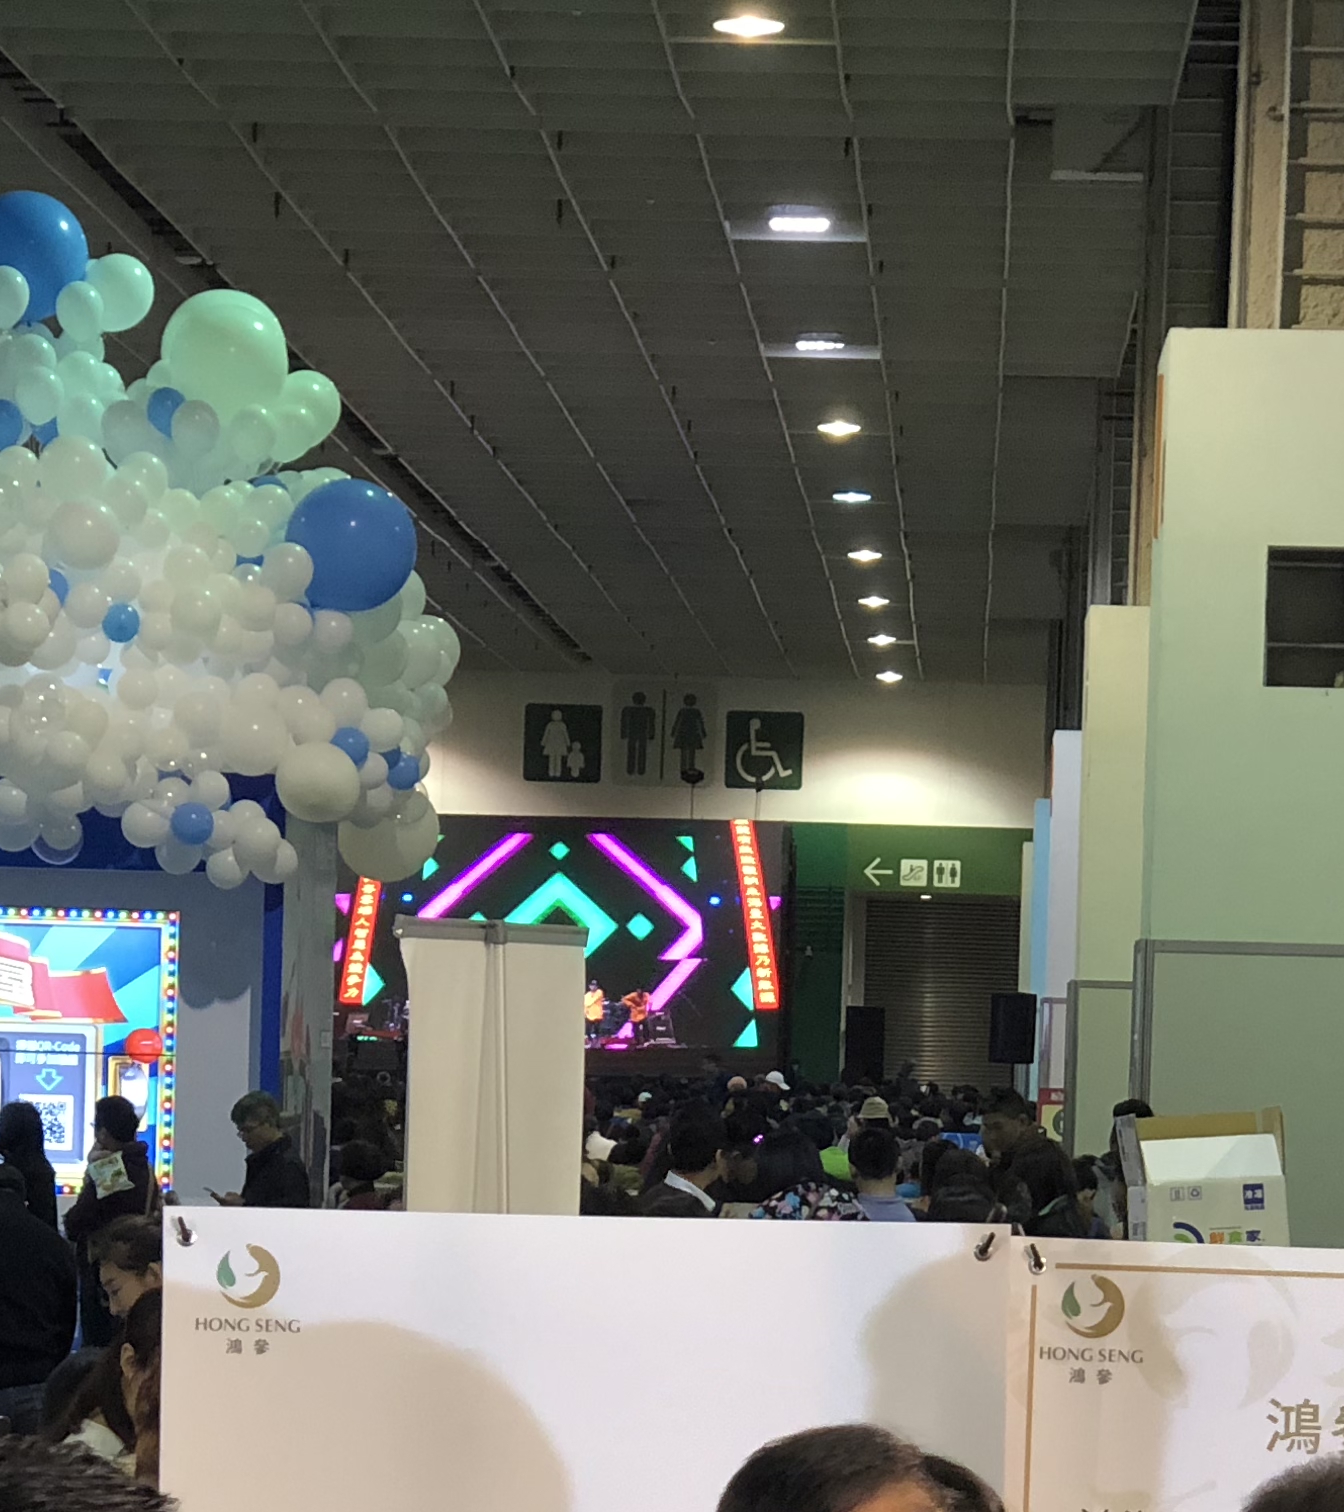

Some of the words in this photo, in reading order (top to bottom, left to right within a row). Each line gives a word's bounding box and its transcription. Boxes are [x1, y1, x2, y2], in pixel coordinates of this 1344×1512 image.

[195, 1317, 250, 1332] HONG
[255, 1318, 301, 1333] SENG
[1039, 1346, 1094, 1362] HONG
[1098, 1348, 1144, 1364] SENG
